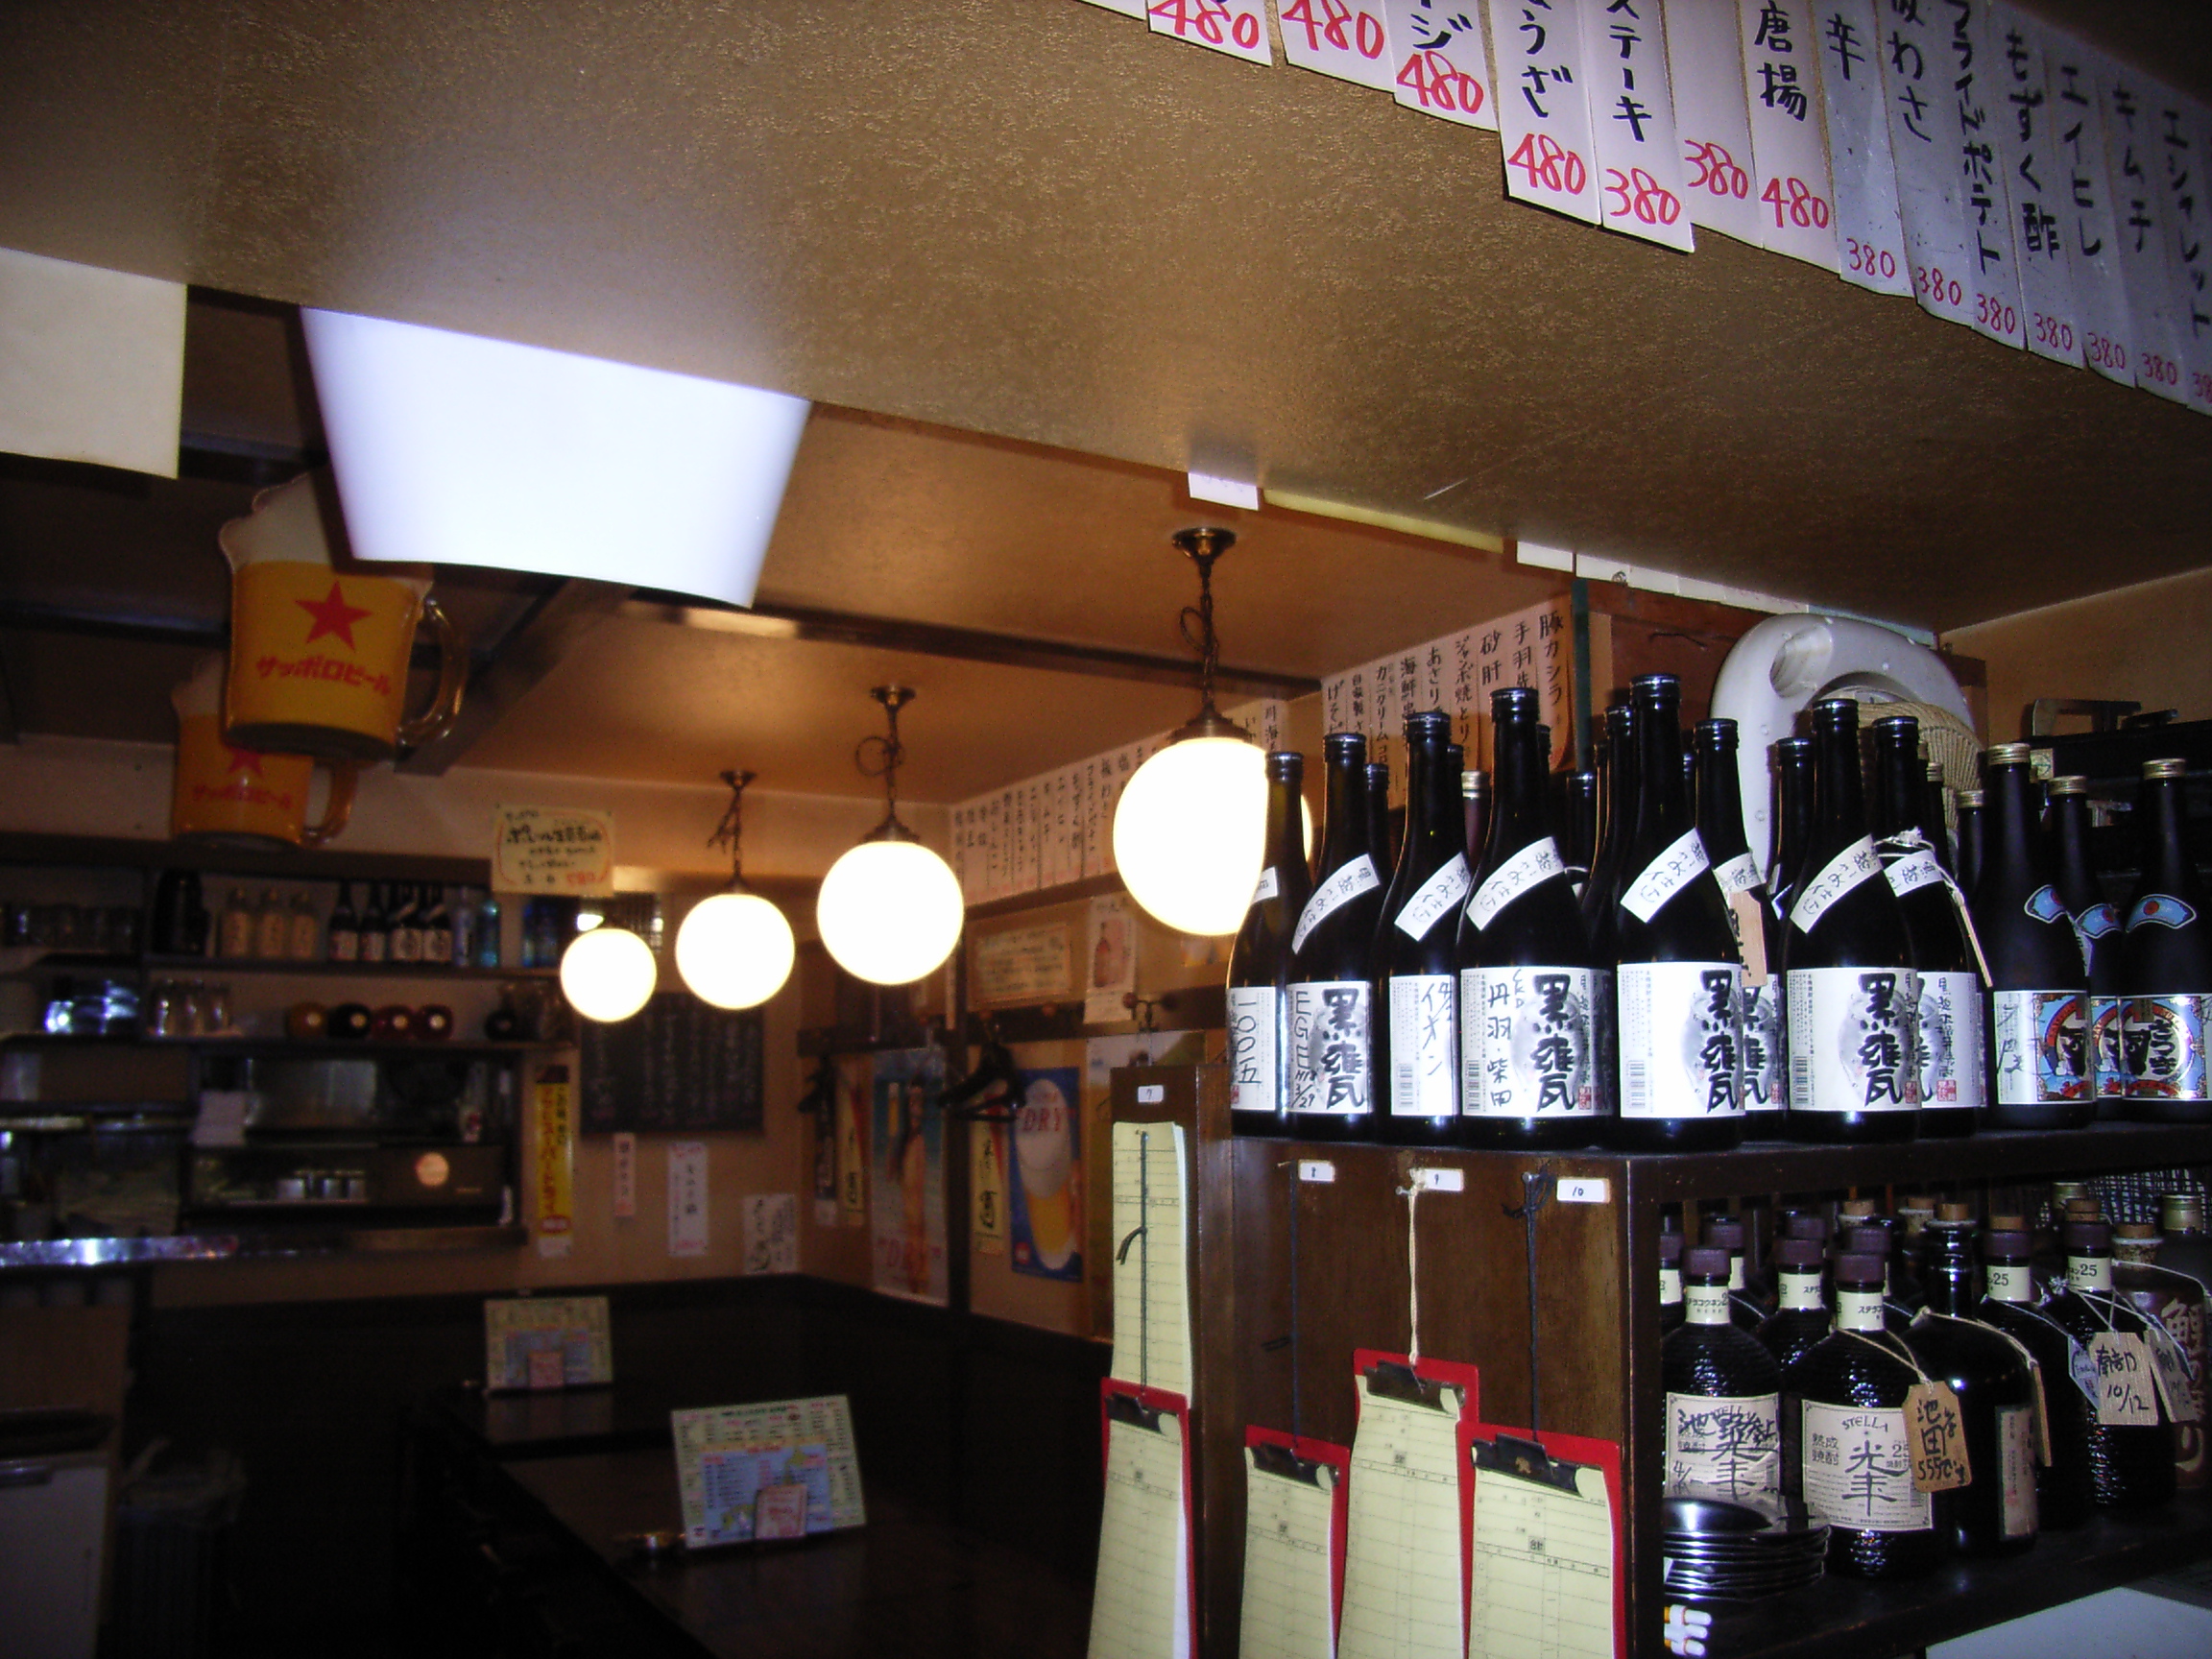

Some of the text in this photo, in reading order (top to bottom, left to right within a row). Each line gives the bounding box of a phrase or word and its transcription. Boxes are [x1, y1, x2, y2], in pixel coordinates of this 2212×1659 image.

[1147, 0, 1260, 50] 480
[1281, 0, 1385, 60] 480
[1396, 50, 1484, 114] 480
[1754, 0, 1807, 122] 唐揚
[1507, 134, 1586, 195] 480
[1685, 140, 1748, 199] 380
[1605, 168, 1681, 226] 380
[1761, 178, 1828, 228] 480
[1845, 237, 1896, 278] 380
[1918, 267, 1961, 305] 380
[1977, 294, 2015, 334] 380
[2033, 312, 2072, 351] 380
[2087, 332, 2126, 370] 380
[2141, 353, 2177, 386] 380
[1479, 629, 1502, 685] 砂肝
[1572, 1187, 1584, 1197] 10
